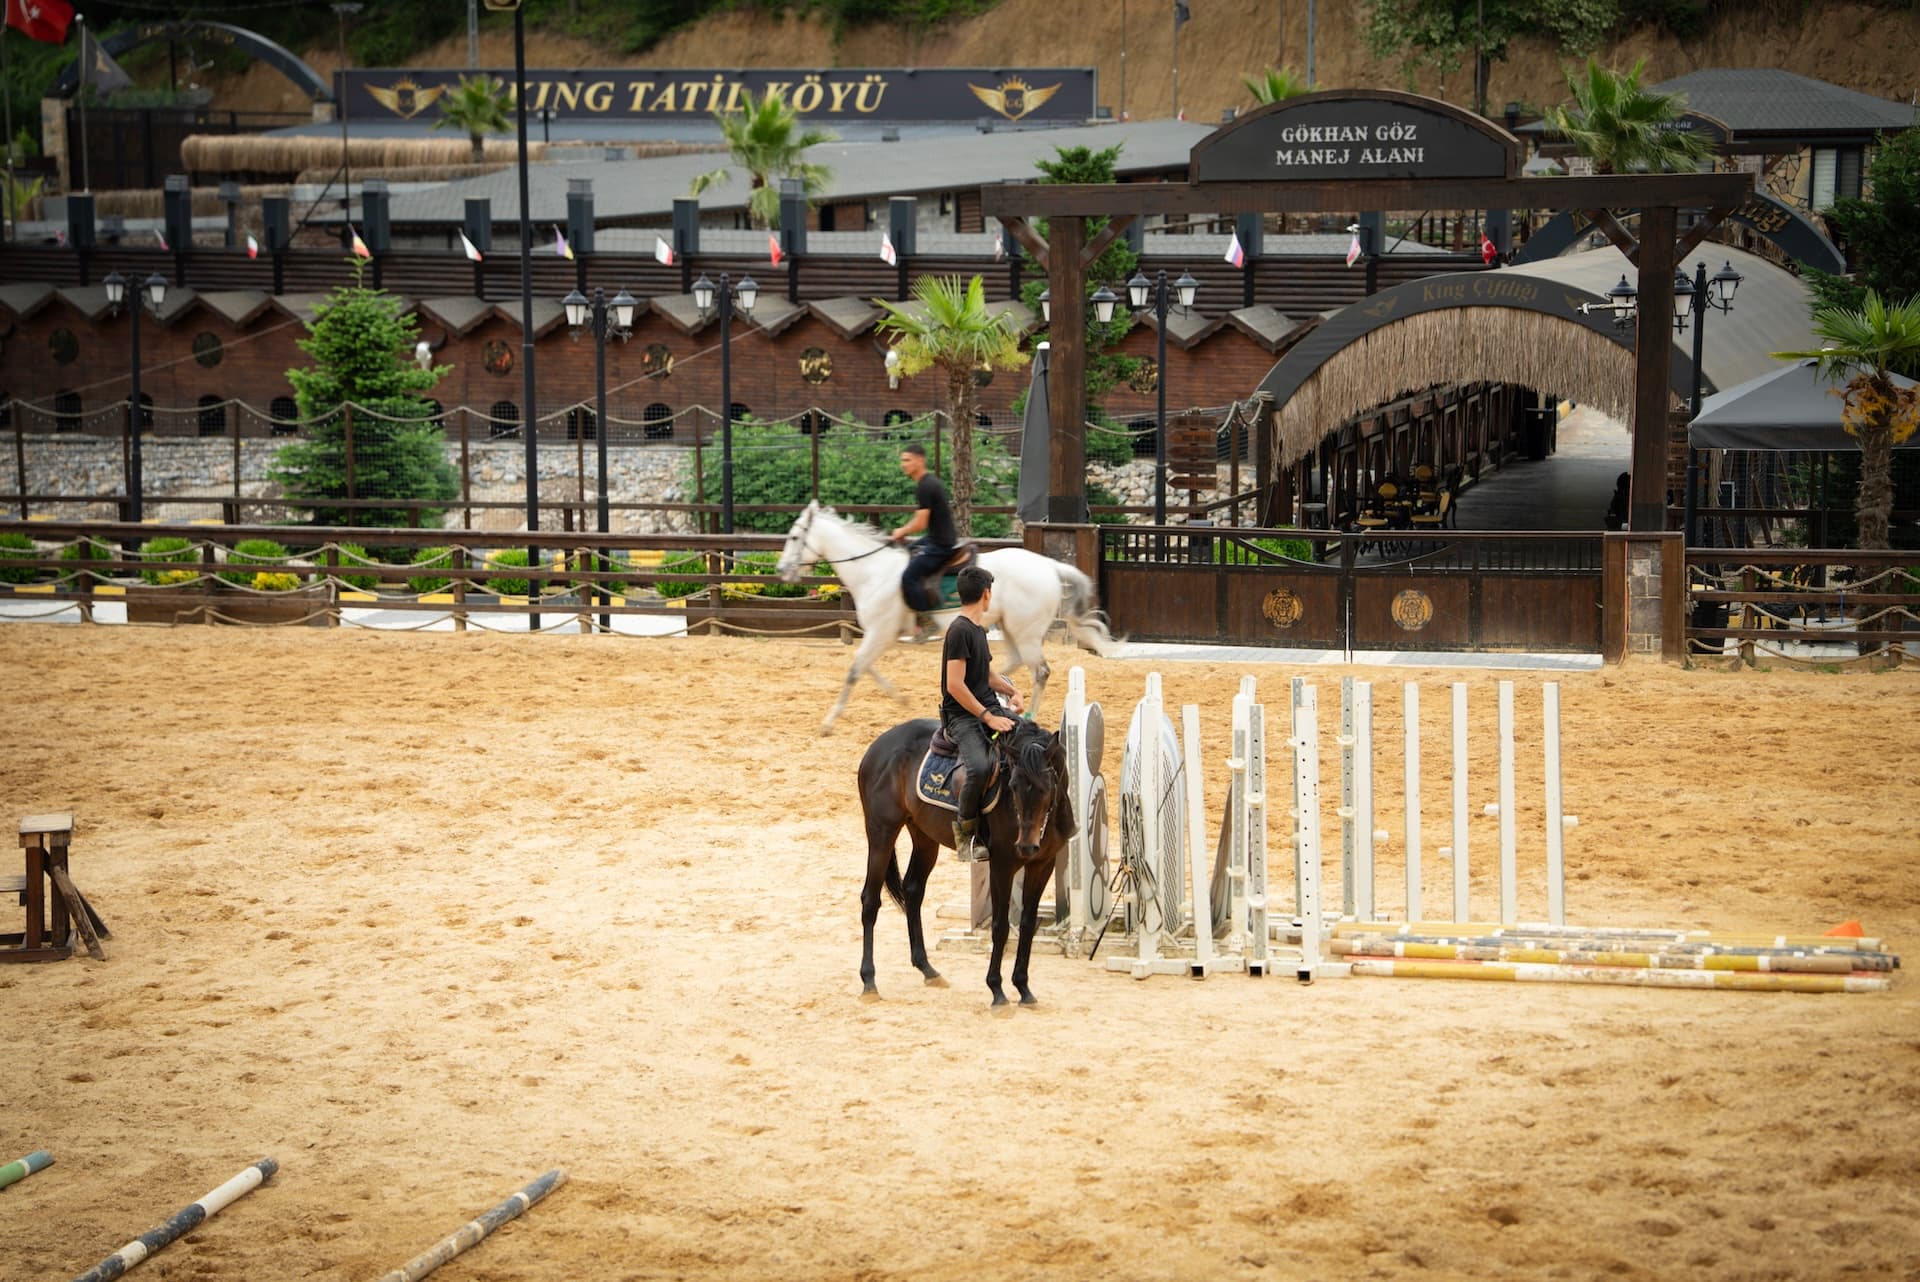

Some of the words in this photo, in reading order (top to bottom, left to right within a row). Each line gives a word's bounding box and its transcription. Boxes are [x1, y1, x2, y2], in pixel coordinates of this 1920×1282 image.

[628, 73, 747, 112] TATİL
[763, 73, 889, 112] KÖYÜ
[1281, 123, 1369, 143] GÖKHAN
[1375, 121, 1417, 141] GÖZ
[1276, 149, 1351, 165] MANEJ
[1359, 147, 1424, 164] ALANI
[1423, 284, 1465, 302] King
